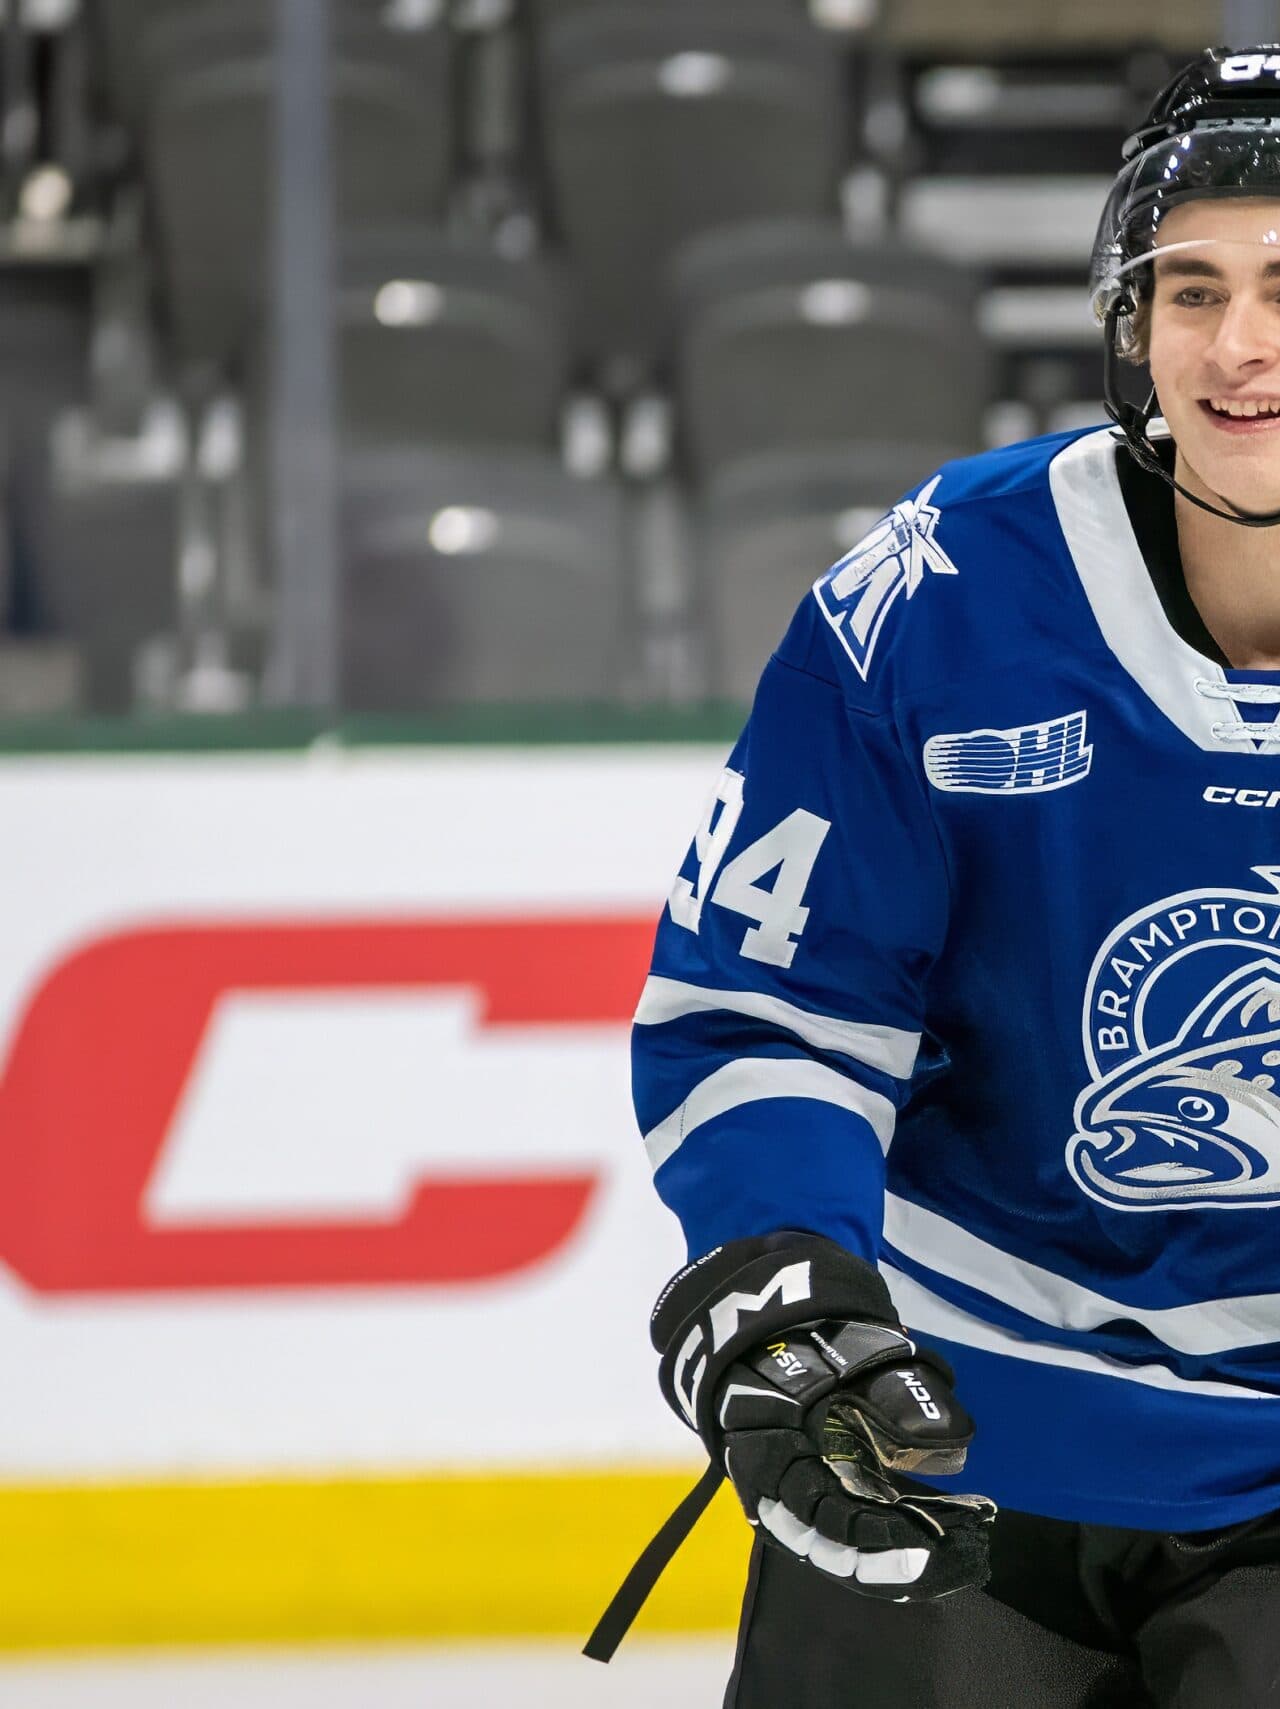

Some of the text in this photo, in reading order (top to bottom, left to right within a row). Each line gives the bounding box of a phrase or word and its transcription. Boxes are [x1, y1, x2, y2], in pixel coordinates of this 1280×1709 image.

[667, 767, 832, 969] 94
[673, 1260, 812, 1430] CM
[896, 1370, 942, 1420] CCM
